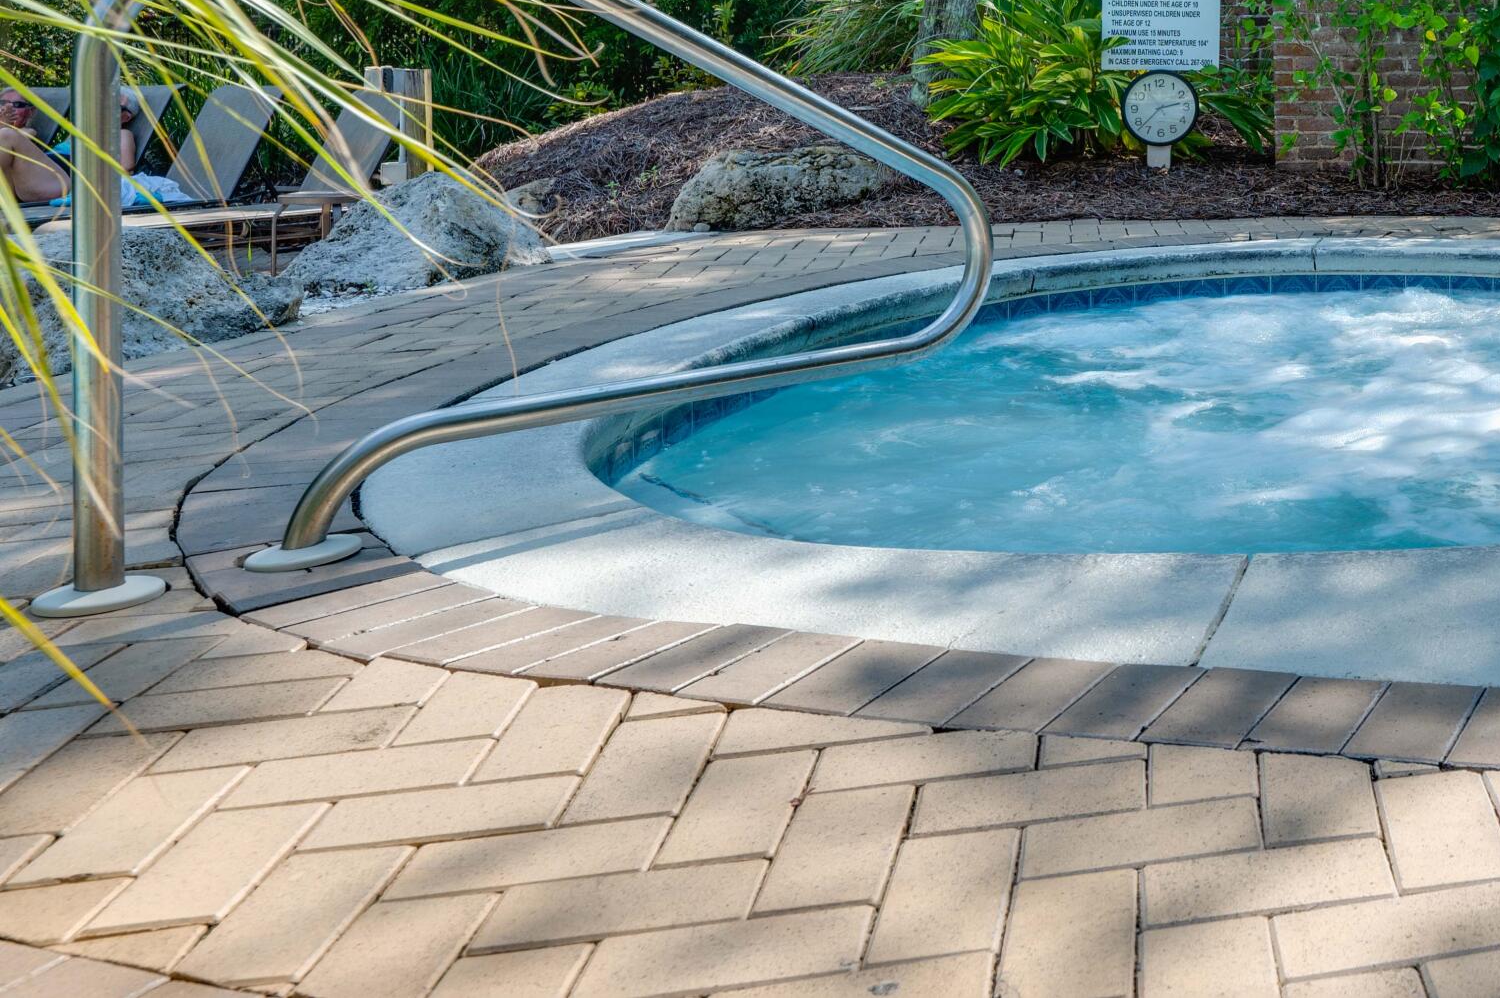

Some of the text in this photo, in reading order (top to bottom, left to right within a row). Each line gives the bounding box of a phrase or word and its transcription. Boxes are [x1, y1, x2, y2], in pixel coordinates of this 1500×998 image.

[1154, 79, 1165, 87] 12
[1135, 92, 1145, 101] 10
[1131, 105, 1138, 113] 9
[1183, 103, 1190, 111] 3
[1135, 118, 1142, 126] 8
[1180, 116, 1186, 124] 4
[1146, 126, 1152, 134] 7
[1157, 129, 1165, 137] 6
[1170, 125, 1177, 133] 5
